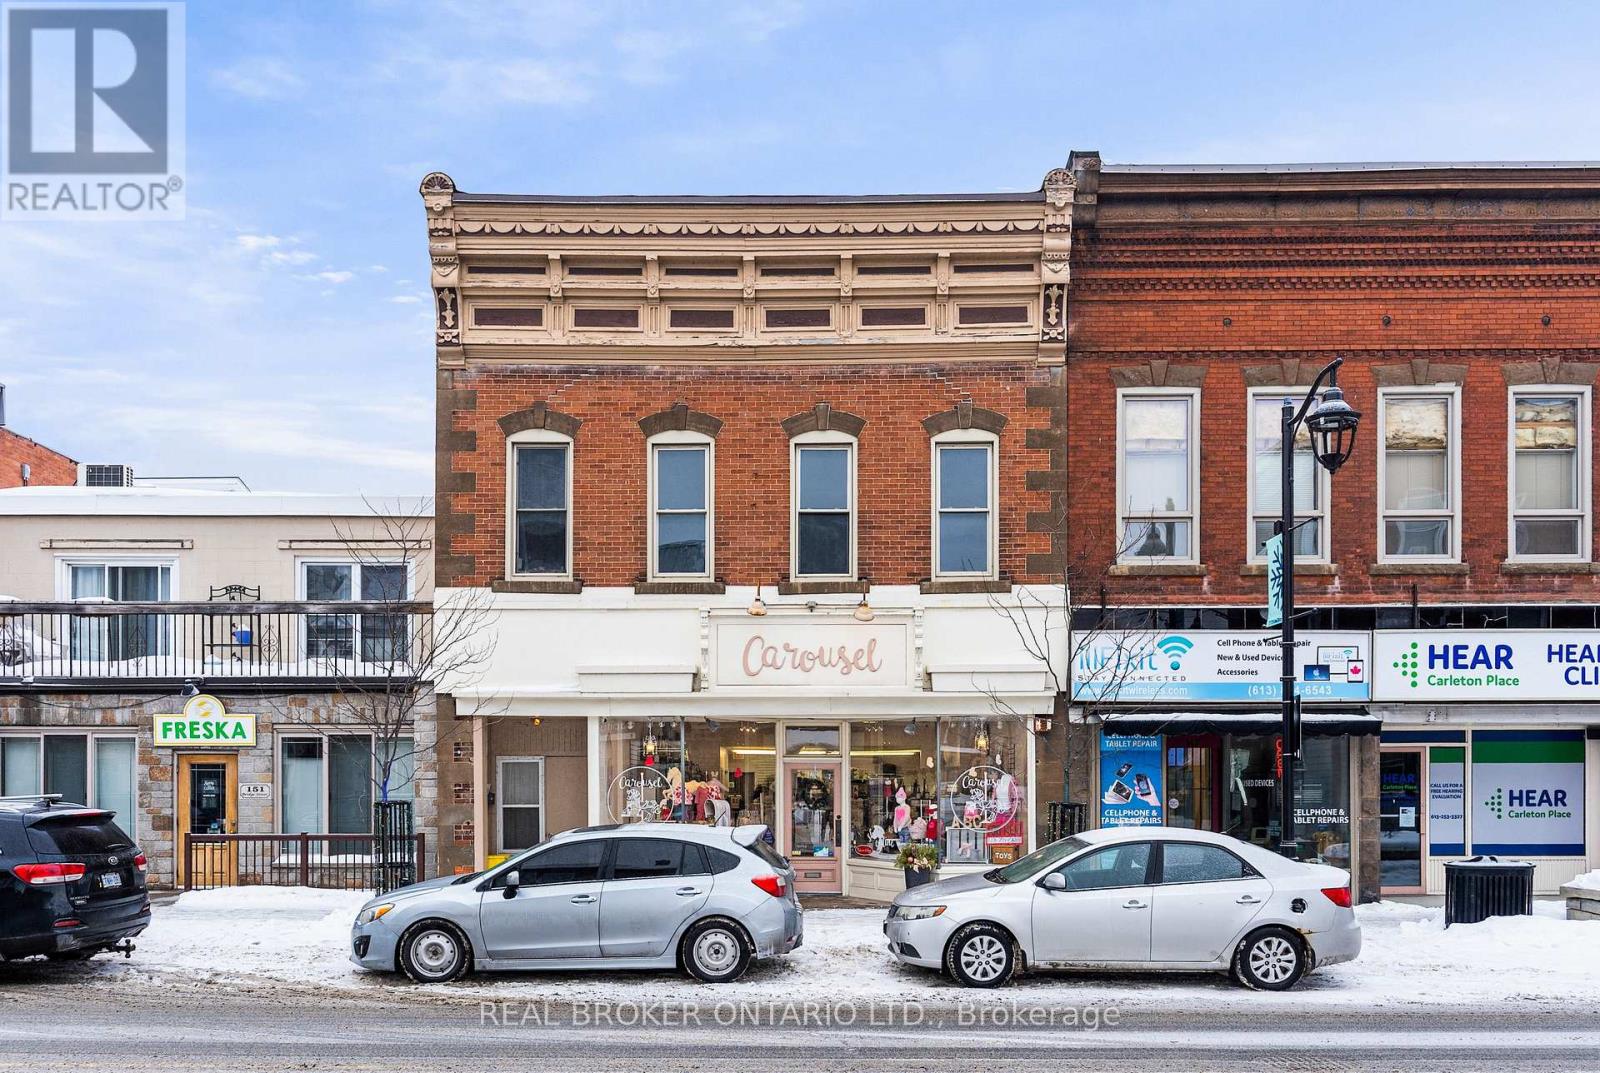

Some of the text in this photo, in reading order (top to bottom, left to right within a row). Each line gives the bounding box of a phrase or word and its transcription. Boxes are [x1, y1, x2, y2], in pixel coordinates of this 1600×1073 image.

[1217, 639, 1231, 647] Cell
[1232, 639, 1255, 647] Phone
[1256, 639, 1263, 647] &
[742, 635, 882, 676] Carousel
[1428, 644, 1514, 670] HEAR
[1547, 644, 1600, 663] HEA
[1427, 674, 1520, 686] Carleton Place
[1248, 685, 1277, 697] (613)
[162, 721, 246, 739] FRESKA
[1383, 774, 1415, 784] HEAR
[1508, 789, 1567, 807] HEAR
[1104, 809, 1150, 817] CELLPHONE
[1339, 808, 1345, 816] &
[1508, 810, 1572, 818] Carleton Place
[1317, 816, 1350, 824] REPAIRS
